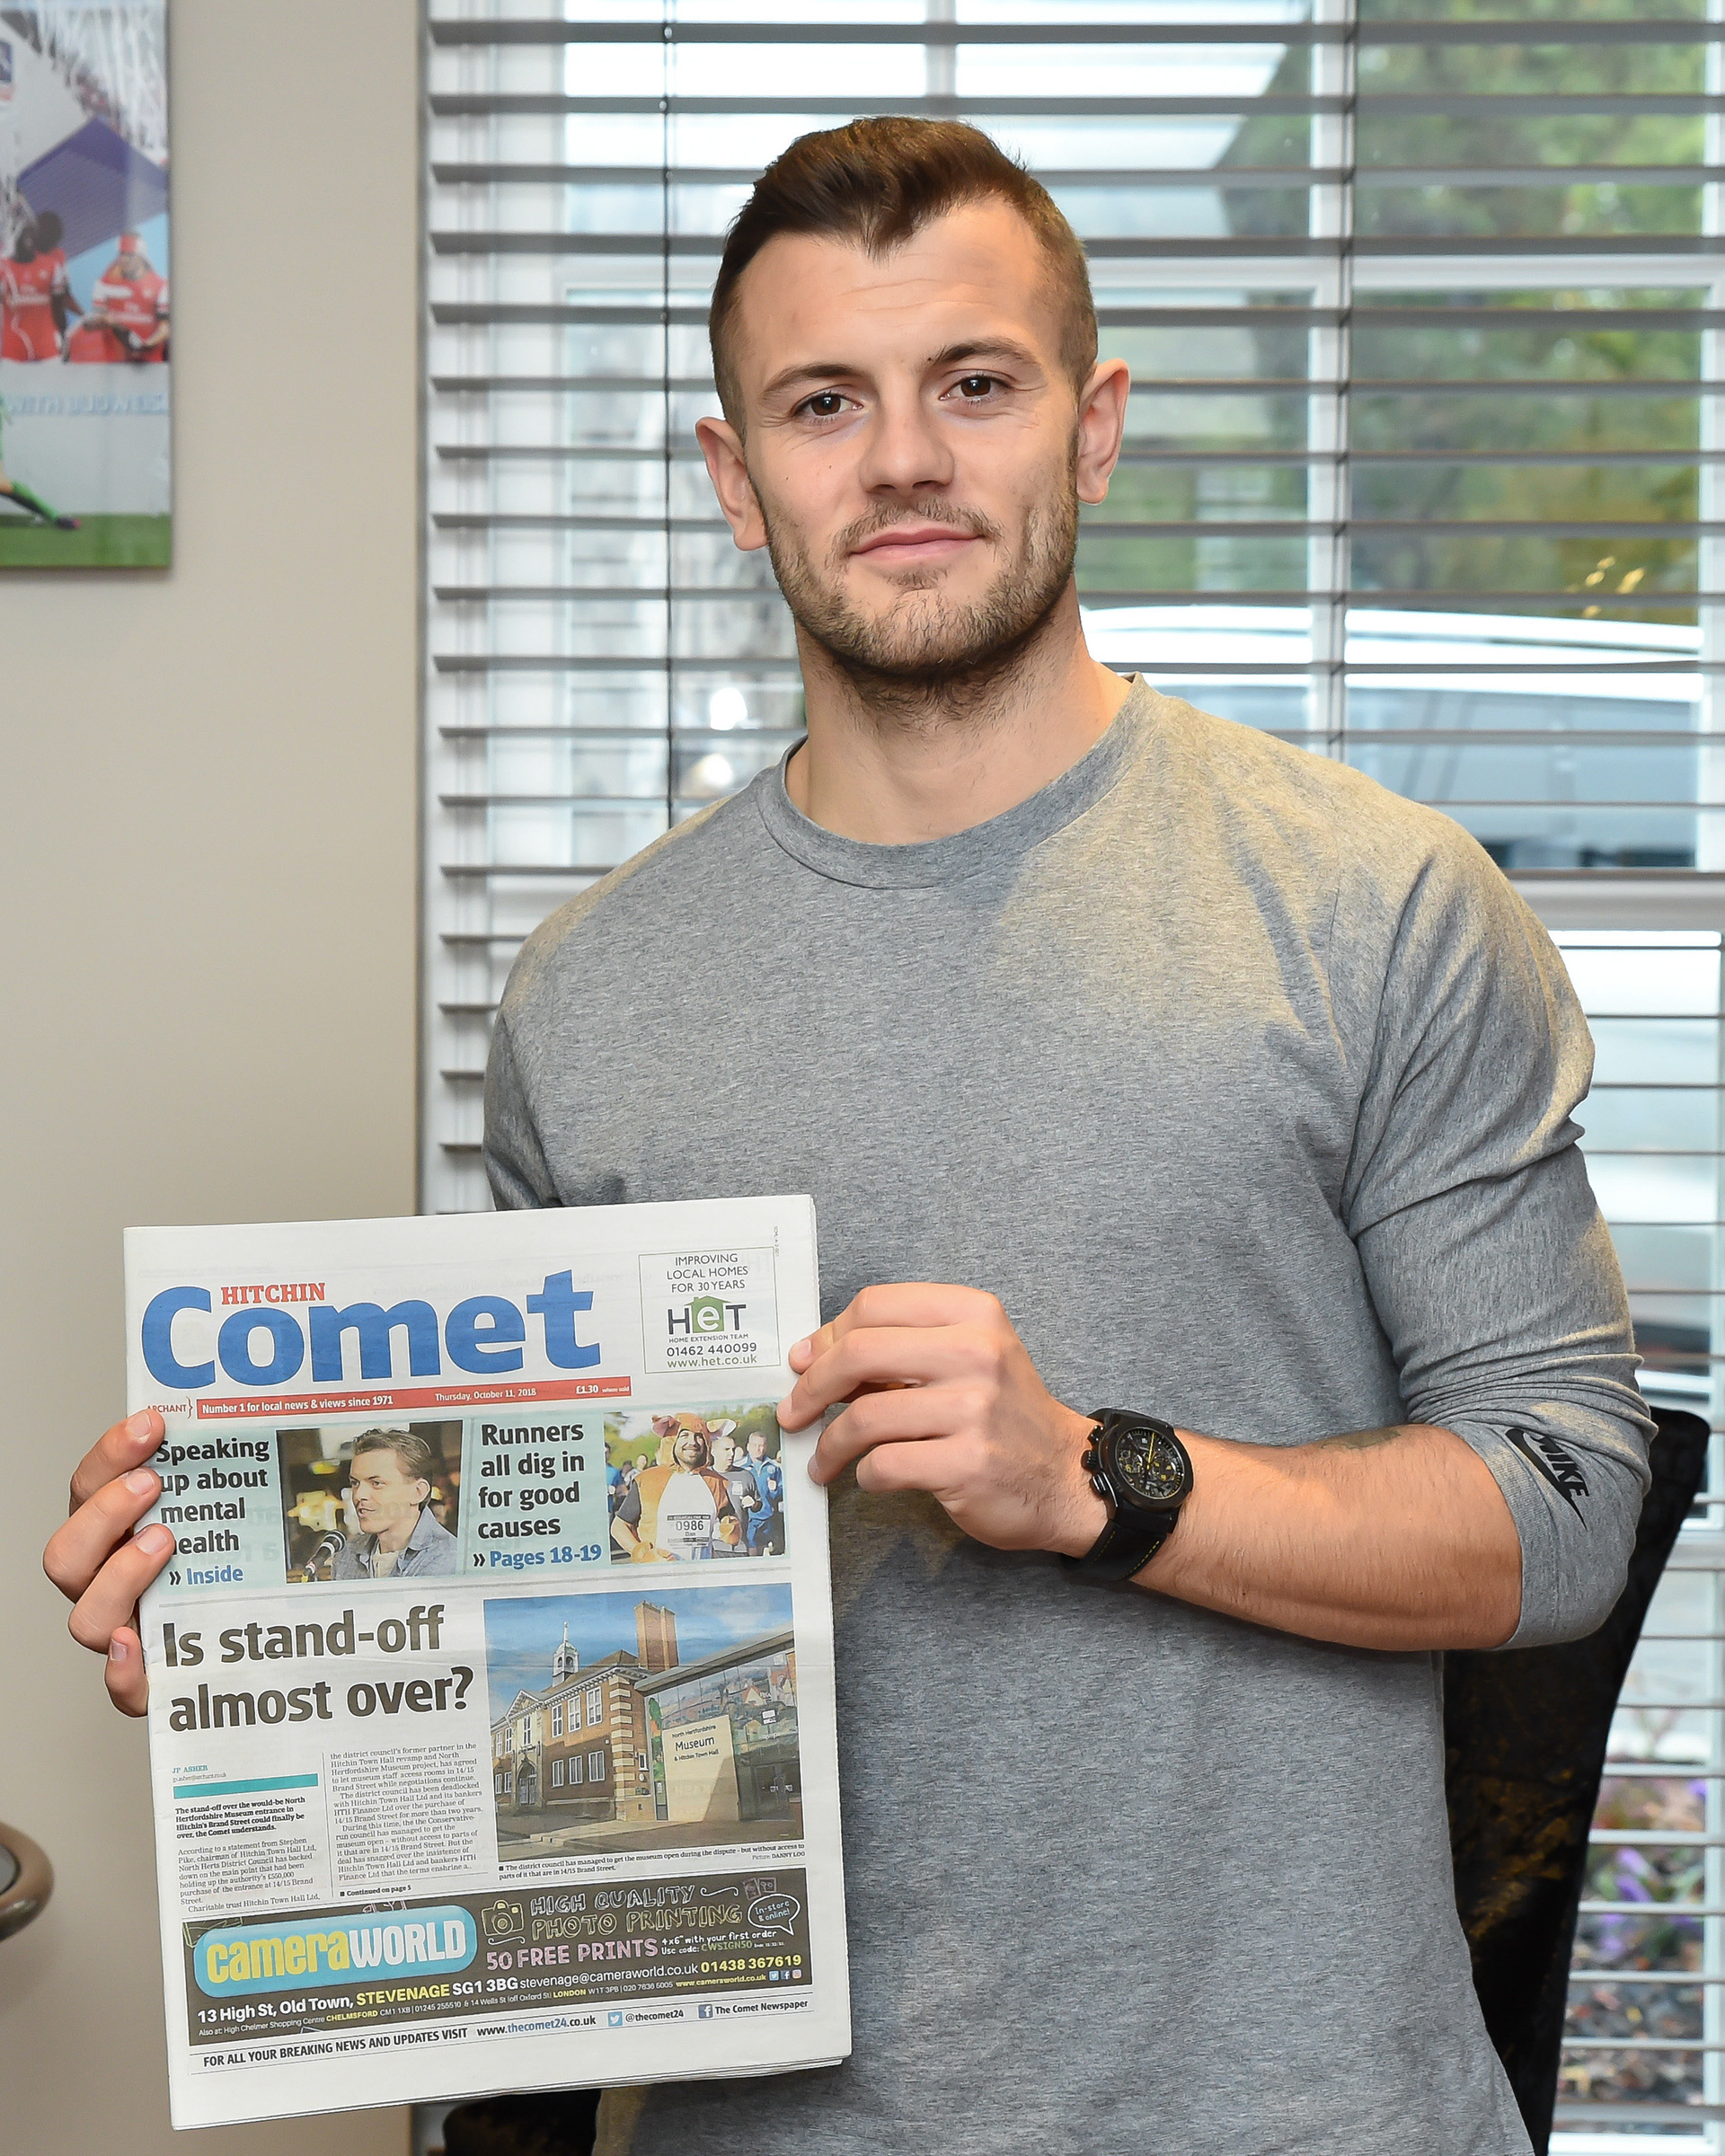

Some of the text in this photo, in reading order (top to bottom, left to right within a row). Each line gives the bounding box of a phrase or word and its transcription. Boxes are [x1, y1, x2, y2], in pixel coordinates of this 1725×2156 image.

[675, 1253, 738, 1266] IMPROVING
[667, 1266, 748, 1279] LOCAL HOMES
[221, 1283, 326, 1306] HITCHIN
[671, 1279, 745, 1293] FOR 30 YEARS
[668, 1303, 747, 1335] HeT
[141, 1269, 601, 1389] Comet
[690, 1334, 728, 1342] EXTENSION
[667, 1342, 756, 1356] 01462 440099
[667, 1354, 756, 1367] www.het.co.uk
[473, 1391, 502, 1399] October
[518, 1387, 536, 1396] 2018
[576, 1384, 598, 1393] £1.30
[202, 1395, 393, 1413] Number 1 for local news & views since 1971
[482, 1421, 584, 1446] Runners
[155, 1438, 270, 1467] Speaking
[481, 1450, 584, 1479] all dig in
[1530, 1436, 1589, 1498] NIKE
[161, 1468, 268, 1497] up about
[479, 1480, 579, 1510] for good
[161, 1497, 245, 1524] mental
[478, 1517, 561, 1538] causes
[676, 1521, 704, 1531] 0986
[490, 1544, 602, 1570] Pages 18-19
[187, 1565, 243, 1585] Inside
[163, 1604, 445, 1667] Is stand-off
[169, 1666, 474, 1732] almost over?
[676, 1736, 715, 1751] Museum
[183, 1764, 208, 1772] ASHER
[190, 1804, 221, 1813] stand-off
[251, 1798, 283, 1807] would-be
[285, 1796, 305, 1804] North
[175, 1812, 223, 1822] Hertfordshire
[224, 1810, 253, 1818] Museum
[176, 1822, 207, 1830] Hitchin's
[208, 1819, 228, 1827] Brand
[251, 1816, 270, 1824] could
[271, 1814, 295, 1822] finally
[231, 1824, 276, 1833] understands.
[577, 1857, 606, 1865] managed
[346, 1887, 380, 1895] Continued
[531, 1886, 695, 1917] HIGH QUALITY
[755, 1901, 790, 1915] In-store
[533, 1904, 742, 1941] PHOTO PRINTING
[765, 1908, 791, 1921] online!
[661, 1935, 684, 1946] 4x6"
[706, 1933, 726, 1946] your
[751, 1929, 777, 1939] order
[207, 1919, 466, 1984] cameraWORLD
[487, 1939, 659, 1971] 50 FREE PRINTS
[661, 1947, 676, 1955] Use
[679, 1946, 699, 1954] code:
[701, 1940, 753, 1951] CWSIGN50
[198, 1954, 801, 2022] 13 High St, Old Town, STEVENAGE SG1 3BG stevenage@cameraworld.co.uk 01438 367619
[326, 2010, 377, 2021] CHELMSFORD
[553, 1989, 586, 1998] LONDON
[676, 1975, 766, 1987] www.cameraworld.co.uk
[625, 2010, 685, 2023] @thecomet24
[714, 2001, 808, 2014] The Comet Newspaper
[476, 2016, 597, 2036] www.thecomet24.co.uk
[203, 2028, 467, 2066] FOR ALL YOUR BREAKING NEWS AND UPDATES VISIT
